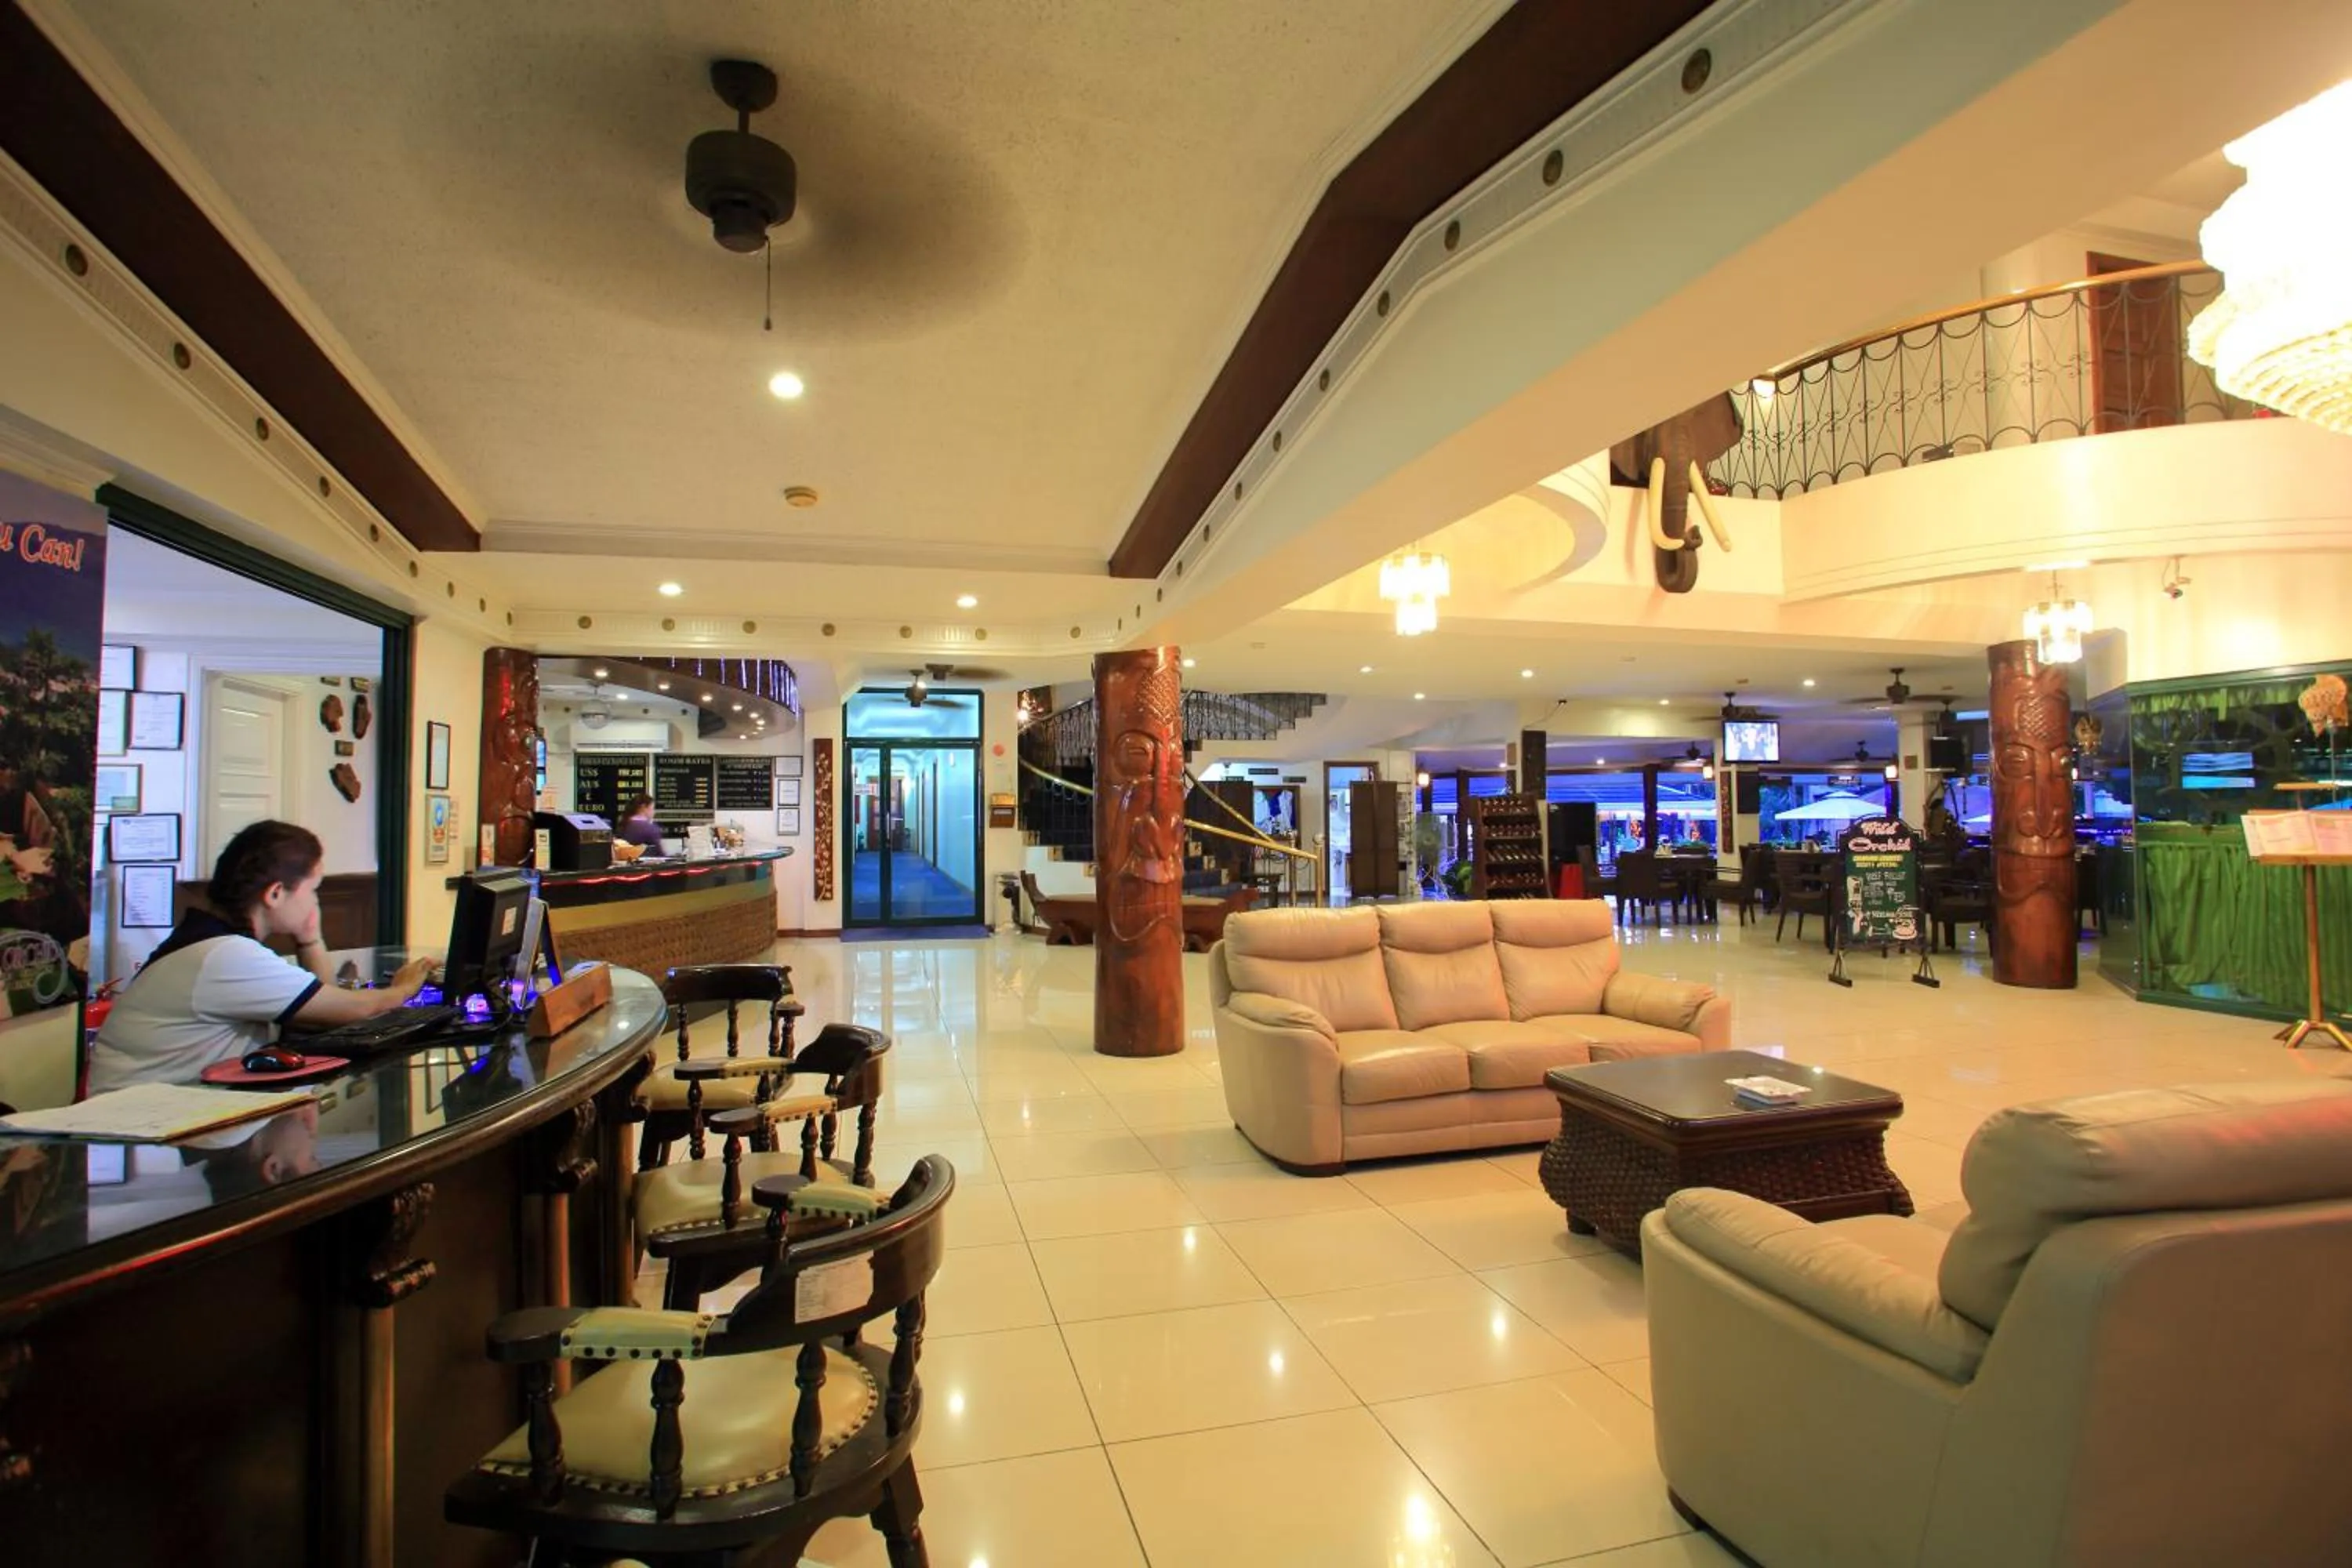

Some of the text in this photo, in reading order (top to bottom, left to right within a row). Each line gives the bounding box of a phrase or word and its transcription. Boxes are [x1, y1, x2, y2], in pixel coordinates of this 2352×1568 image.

[20, 524, 85, 572] Can!
[1861, 821, 1900, 836] Wild
[1848, 837, 1911, 852] Orchid
